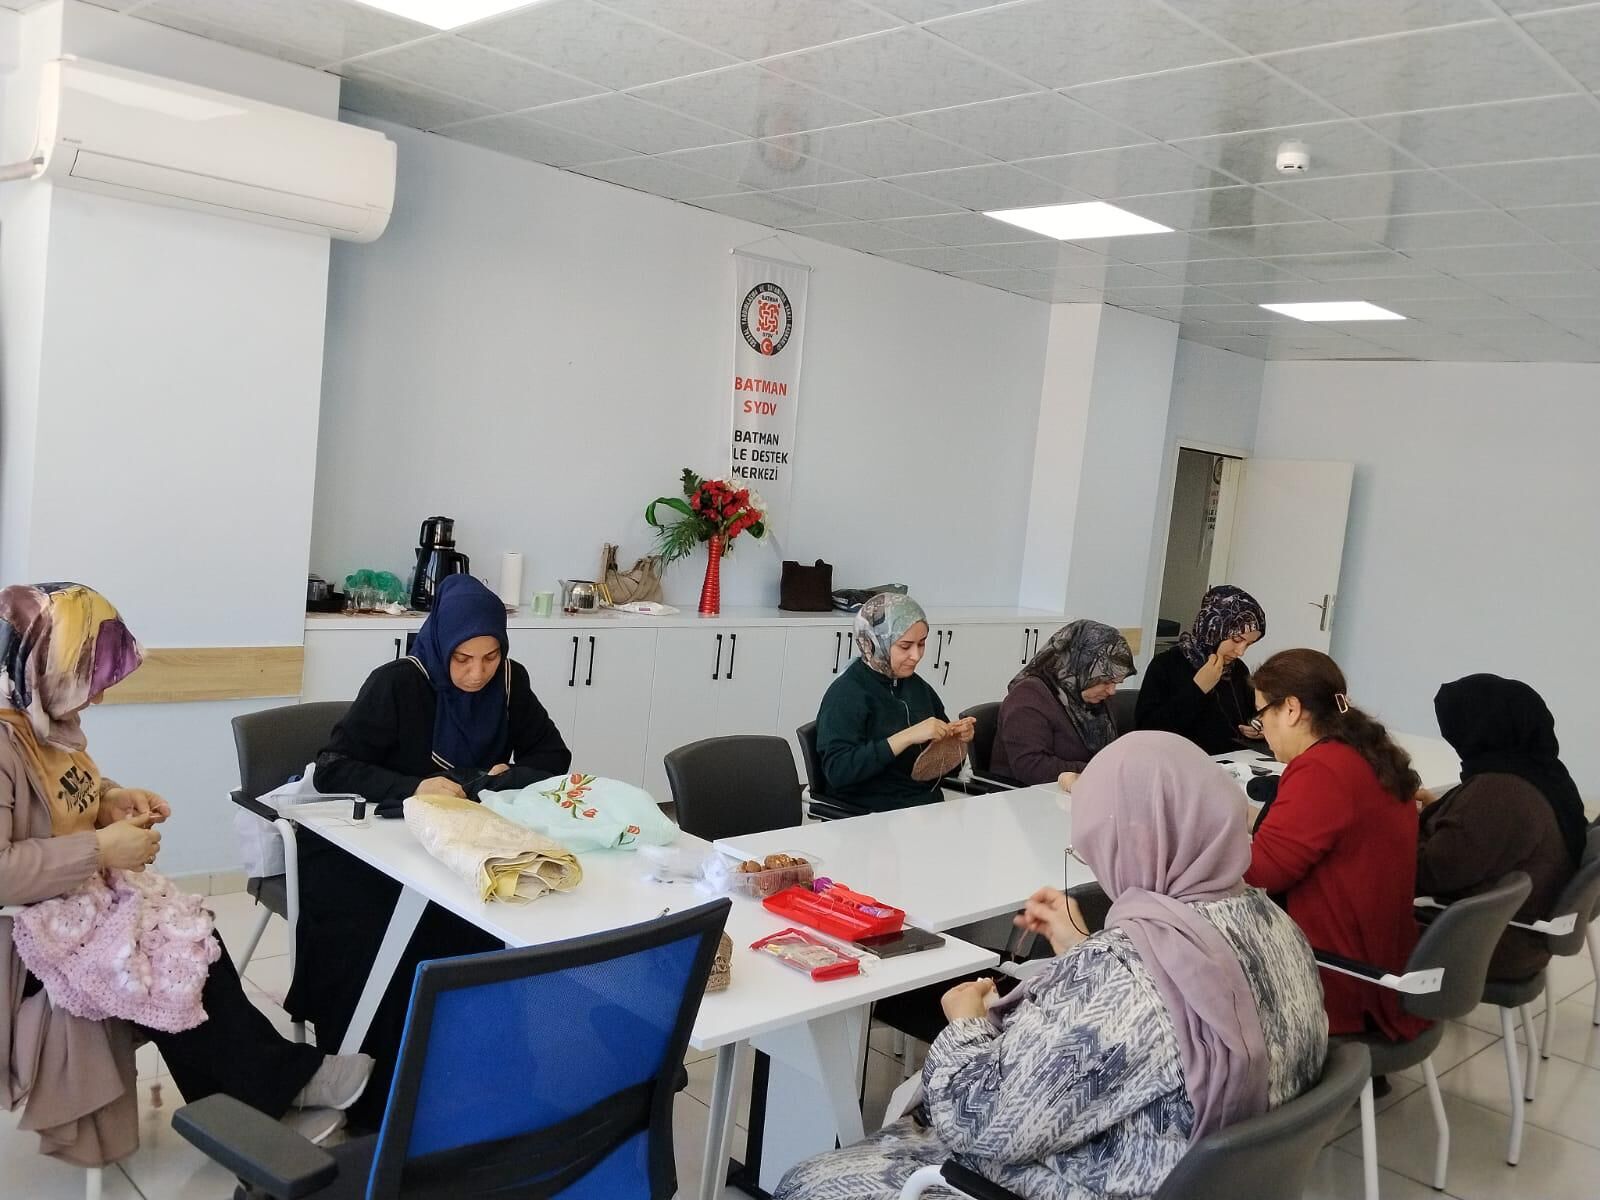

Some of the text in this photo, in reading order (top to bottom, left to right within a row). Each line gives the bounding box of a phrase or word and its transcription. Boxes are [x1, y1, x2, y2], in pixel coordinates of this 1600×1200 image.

[735, 376, 787, 396] BATMAN
[743, 400, 777, 416] SYDV
[734, 430, 779, 446] BATMAN
[732, 447, 788, 464] LE DESTEK
[731, 465, 778, 481] MERKEZİ
